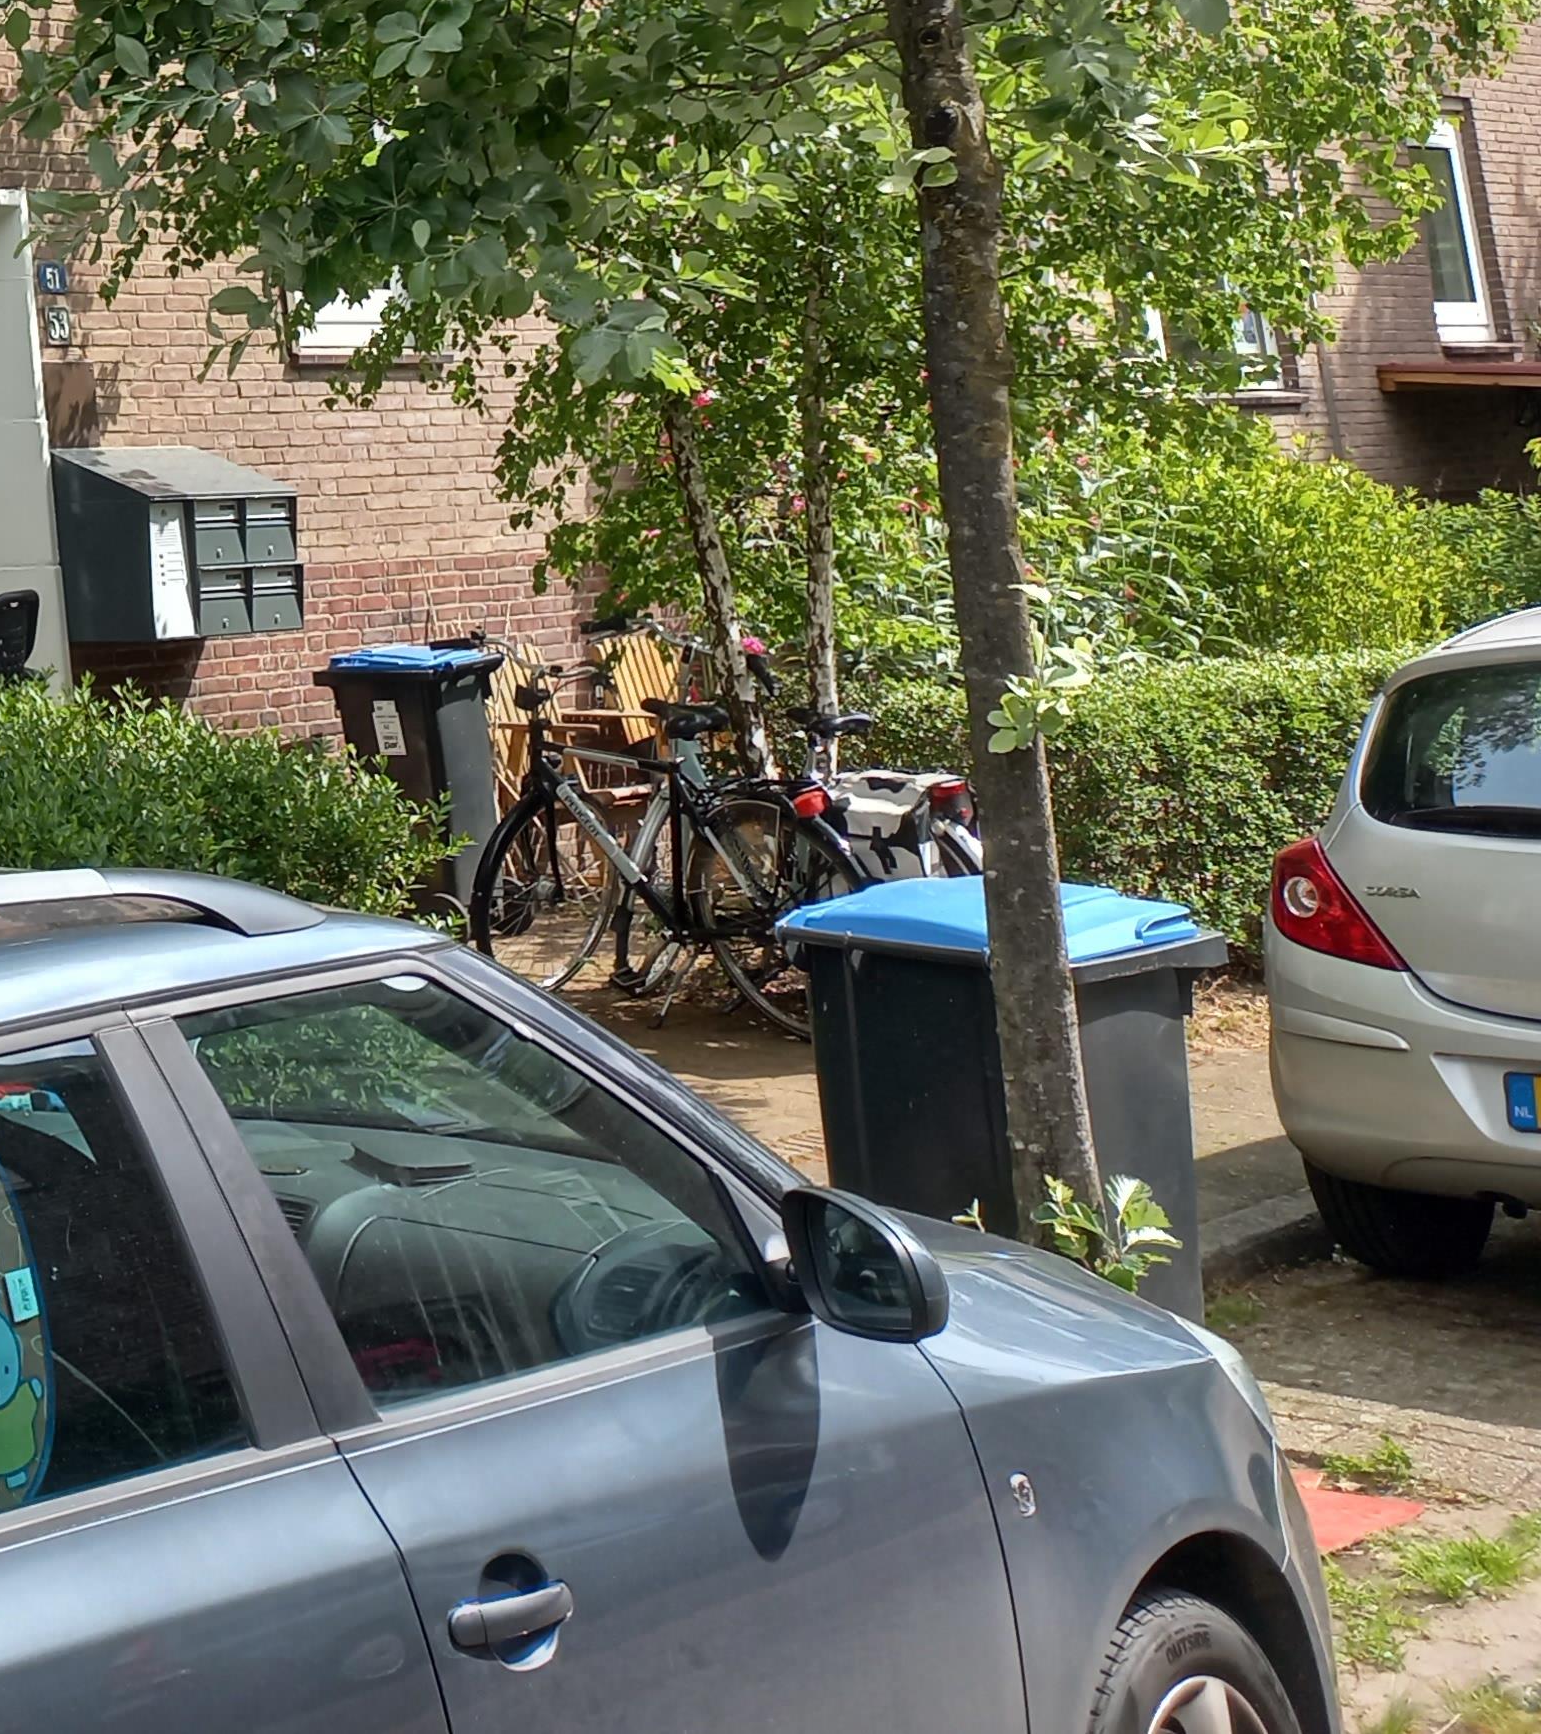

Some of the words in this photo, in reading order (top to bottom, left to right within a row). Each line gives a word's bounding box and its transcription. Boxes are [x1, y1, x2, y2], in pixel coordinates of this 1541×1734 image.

[45, 267, 60, 290] 51
[48, 311, 69, 339] 53
[1364, 886, 1421, 899] CORSA
[1514, 1105, 1534, 1118] NL
[1165, 1630, 1211, 1665] OUTSIDE
